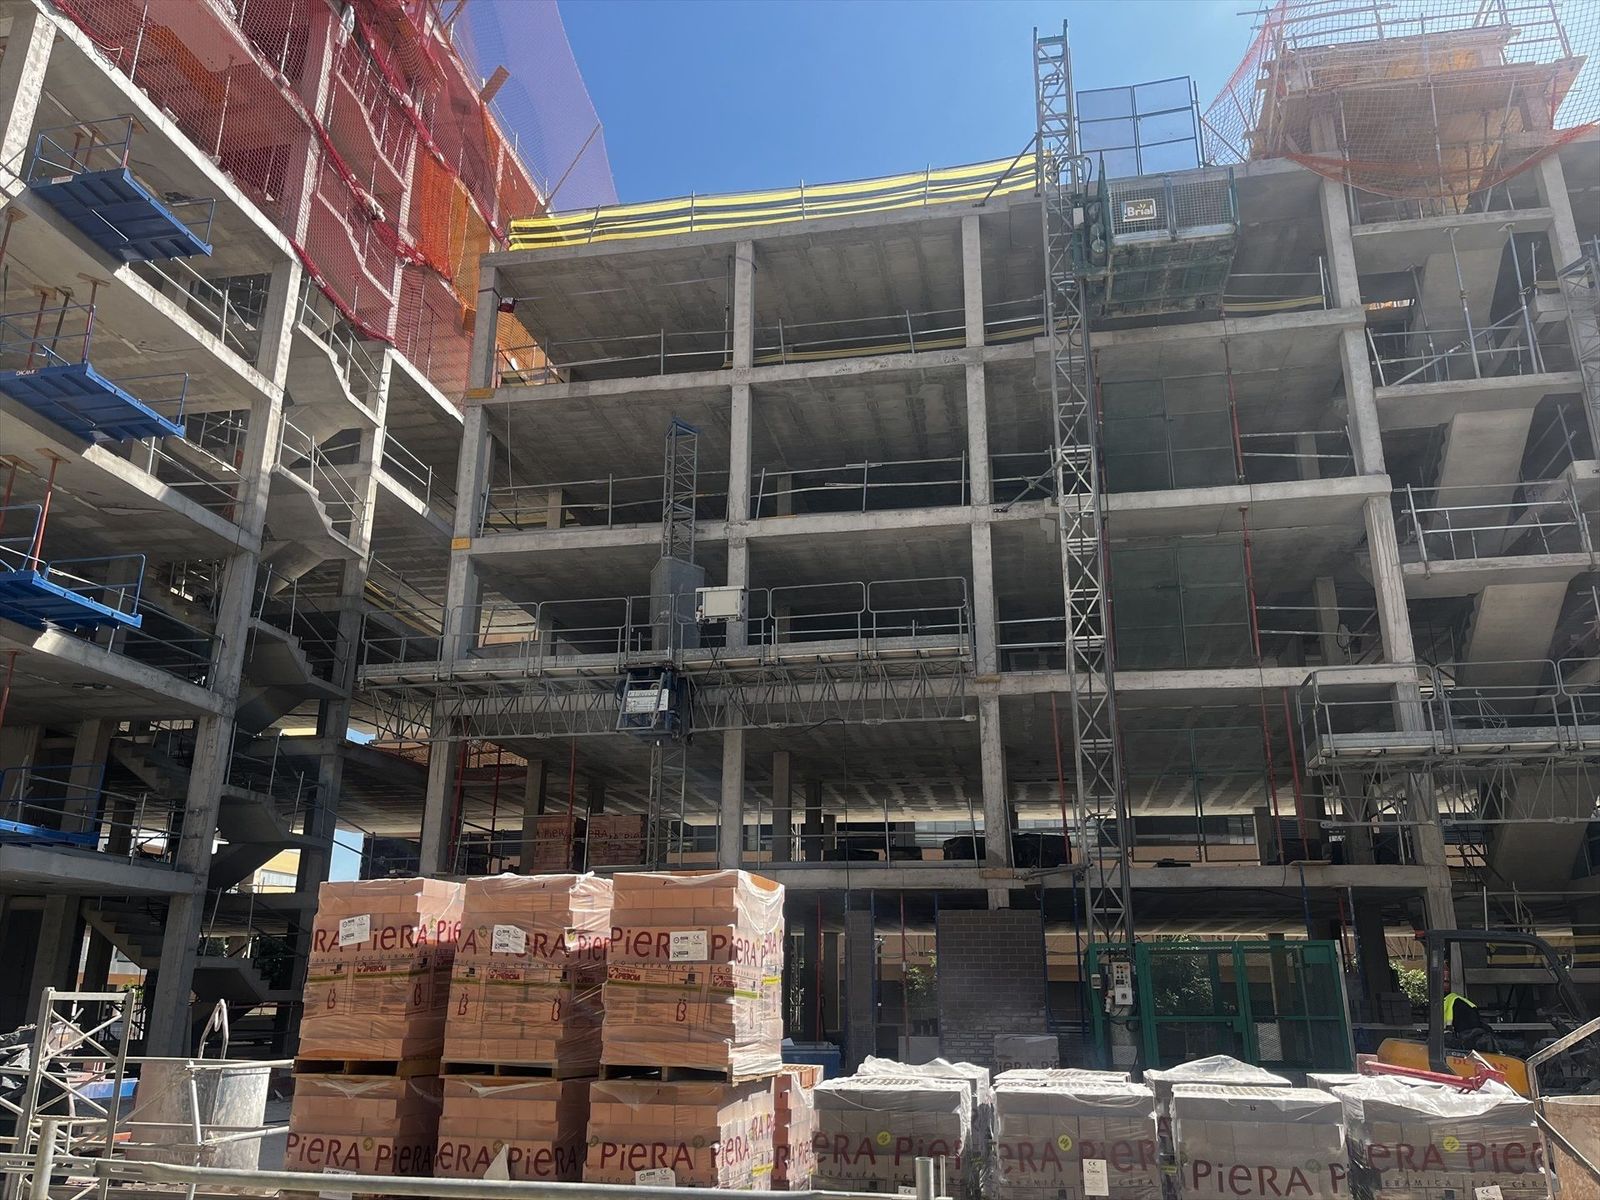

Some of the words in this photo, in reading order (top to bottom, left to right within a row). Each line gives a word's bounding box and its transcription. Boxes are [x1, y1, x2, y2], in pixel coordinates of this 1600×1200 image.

[1127, 204, 1153, 217] Brial
[356, 922, 428, 951] ieRA
[489, 932, 569, 958] eRA
[610, 926, 671, 958] PieR
[286, 1132, 360, 1169] PieRA
[375, 1143, 432, 1174] PieRA
[508, 1146, 577, 1177] PieRA
[600, 1141, 694, 1172] PieRA
[1192, 1159, 1314, 1197] PieRA
